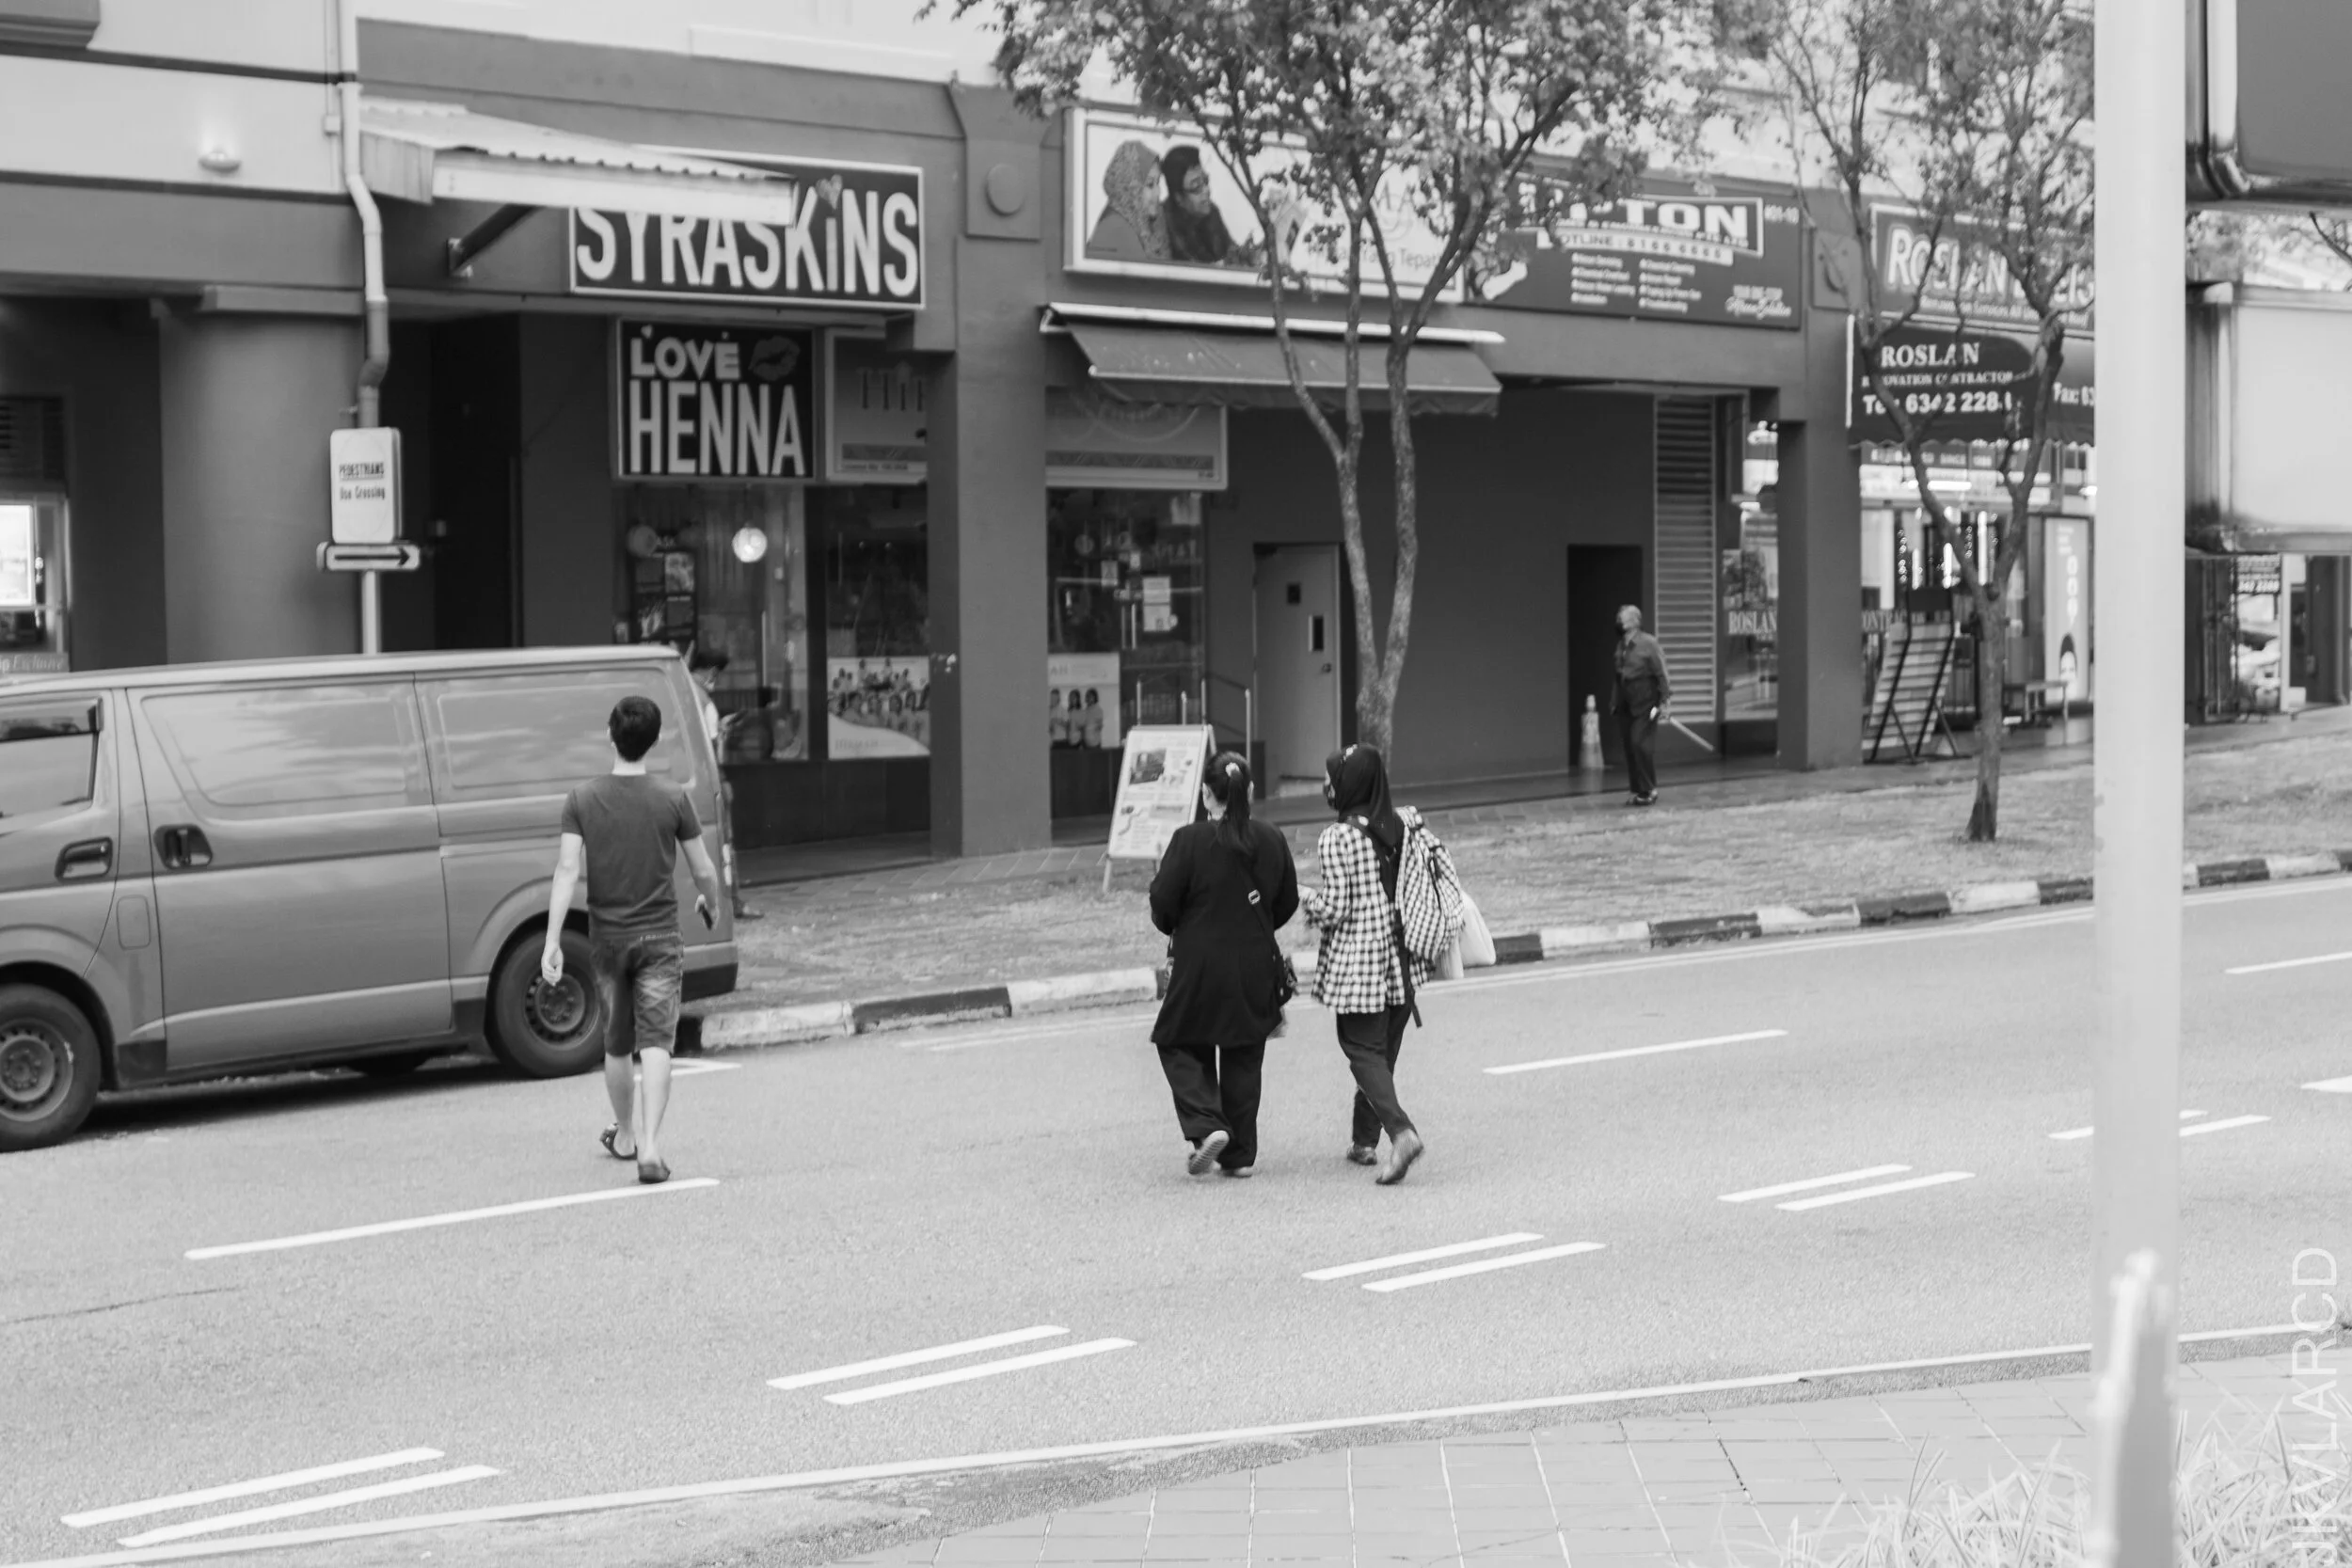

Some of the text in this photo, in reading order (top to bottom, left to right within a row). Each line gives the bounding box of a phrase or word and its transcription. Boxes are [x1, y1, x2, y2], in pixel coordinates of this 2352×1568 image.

[630, 337, 740, 379] LOVE
[1882, 342, 1979, 368] ROSLAN
[1861, 372, 1932, 388] ROVATION
[629, 379, 805, 477] HENNA
